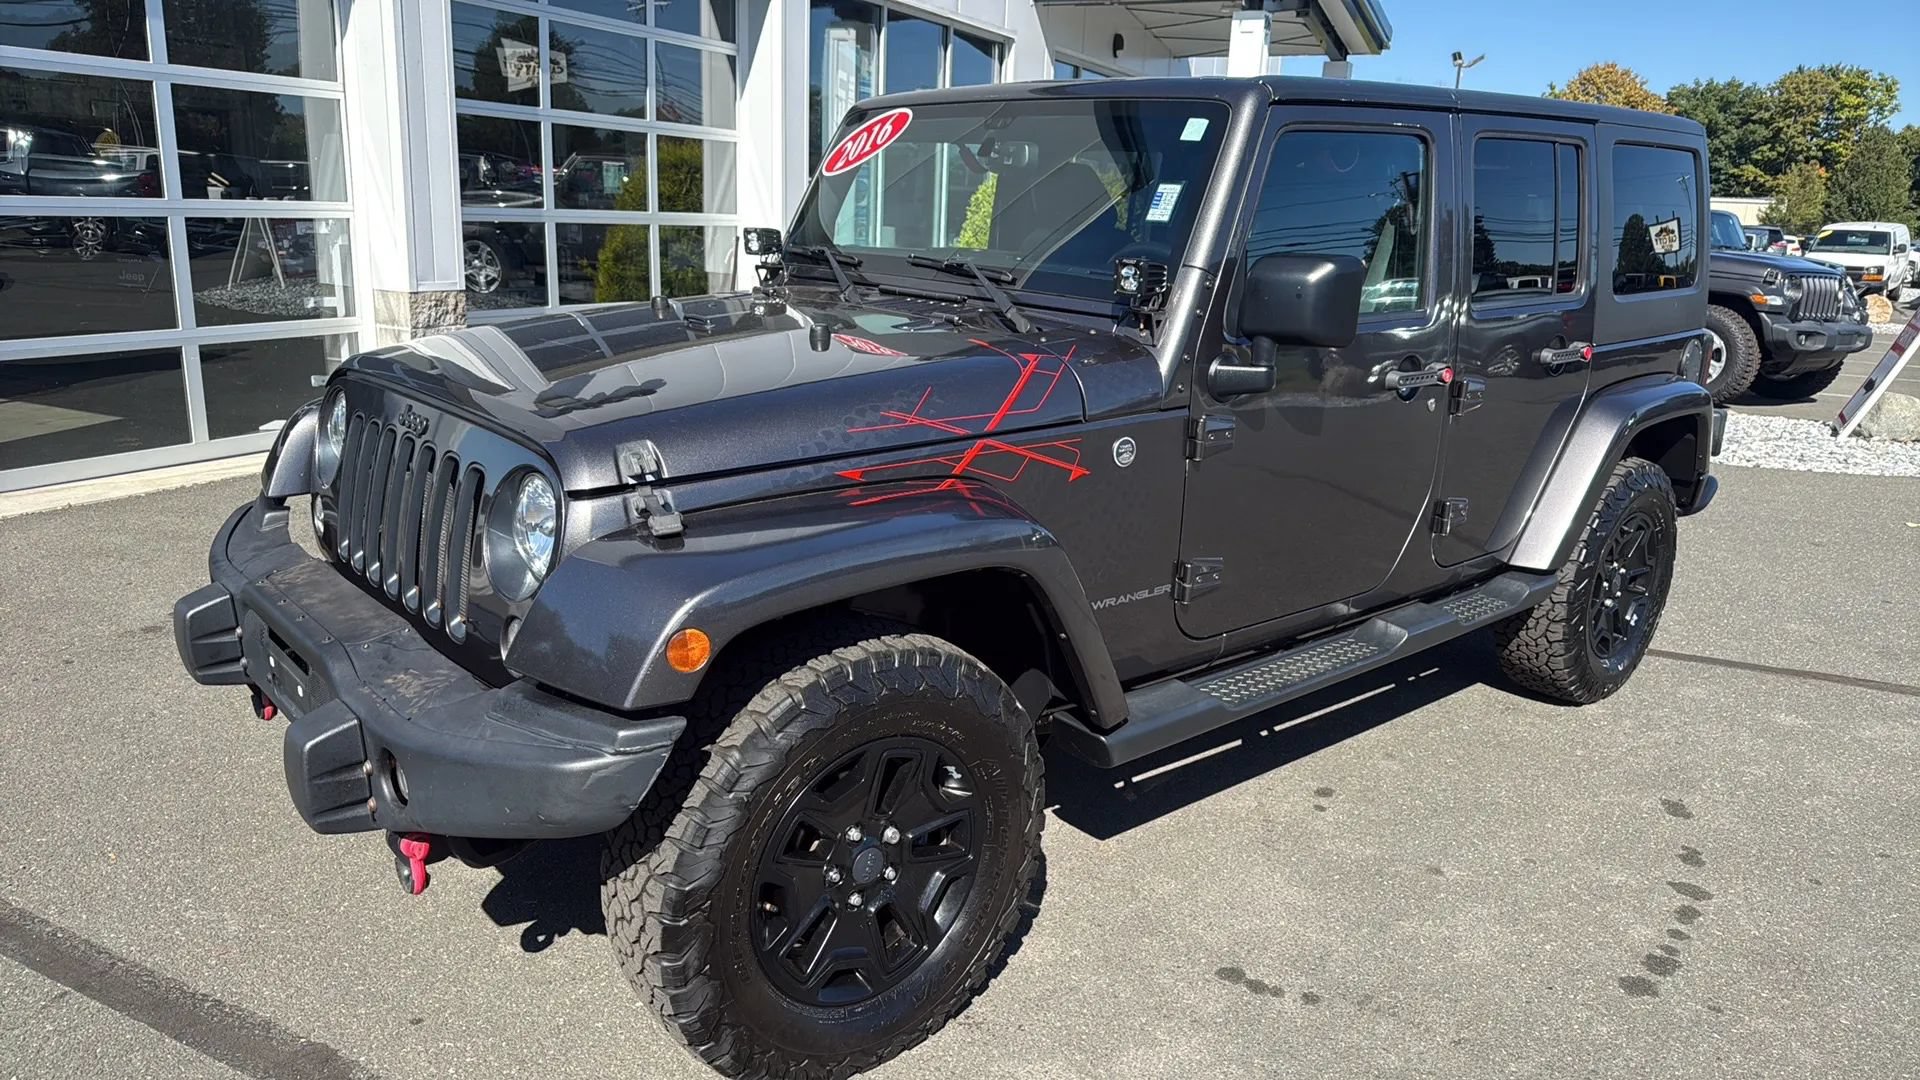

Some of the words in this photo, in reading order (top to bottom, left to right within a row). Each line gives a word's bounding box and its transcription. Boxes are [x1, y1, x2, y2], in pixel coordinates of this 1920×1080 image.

[833, 113, 899, 171] 2016
[398, 403, 430, 439] Jeep
[1091, 584, 1172, 610] WRANGLER
